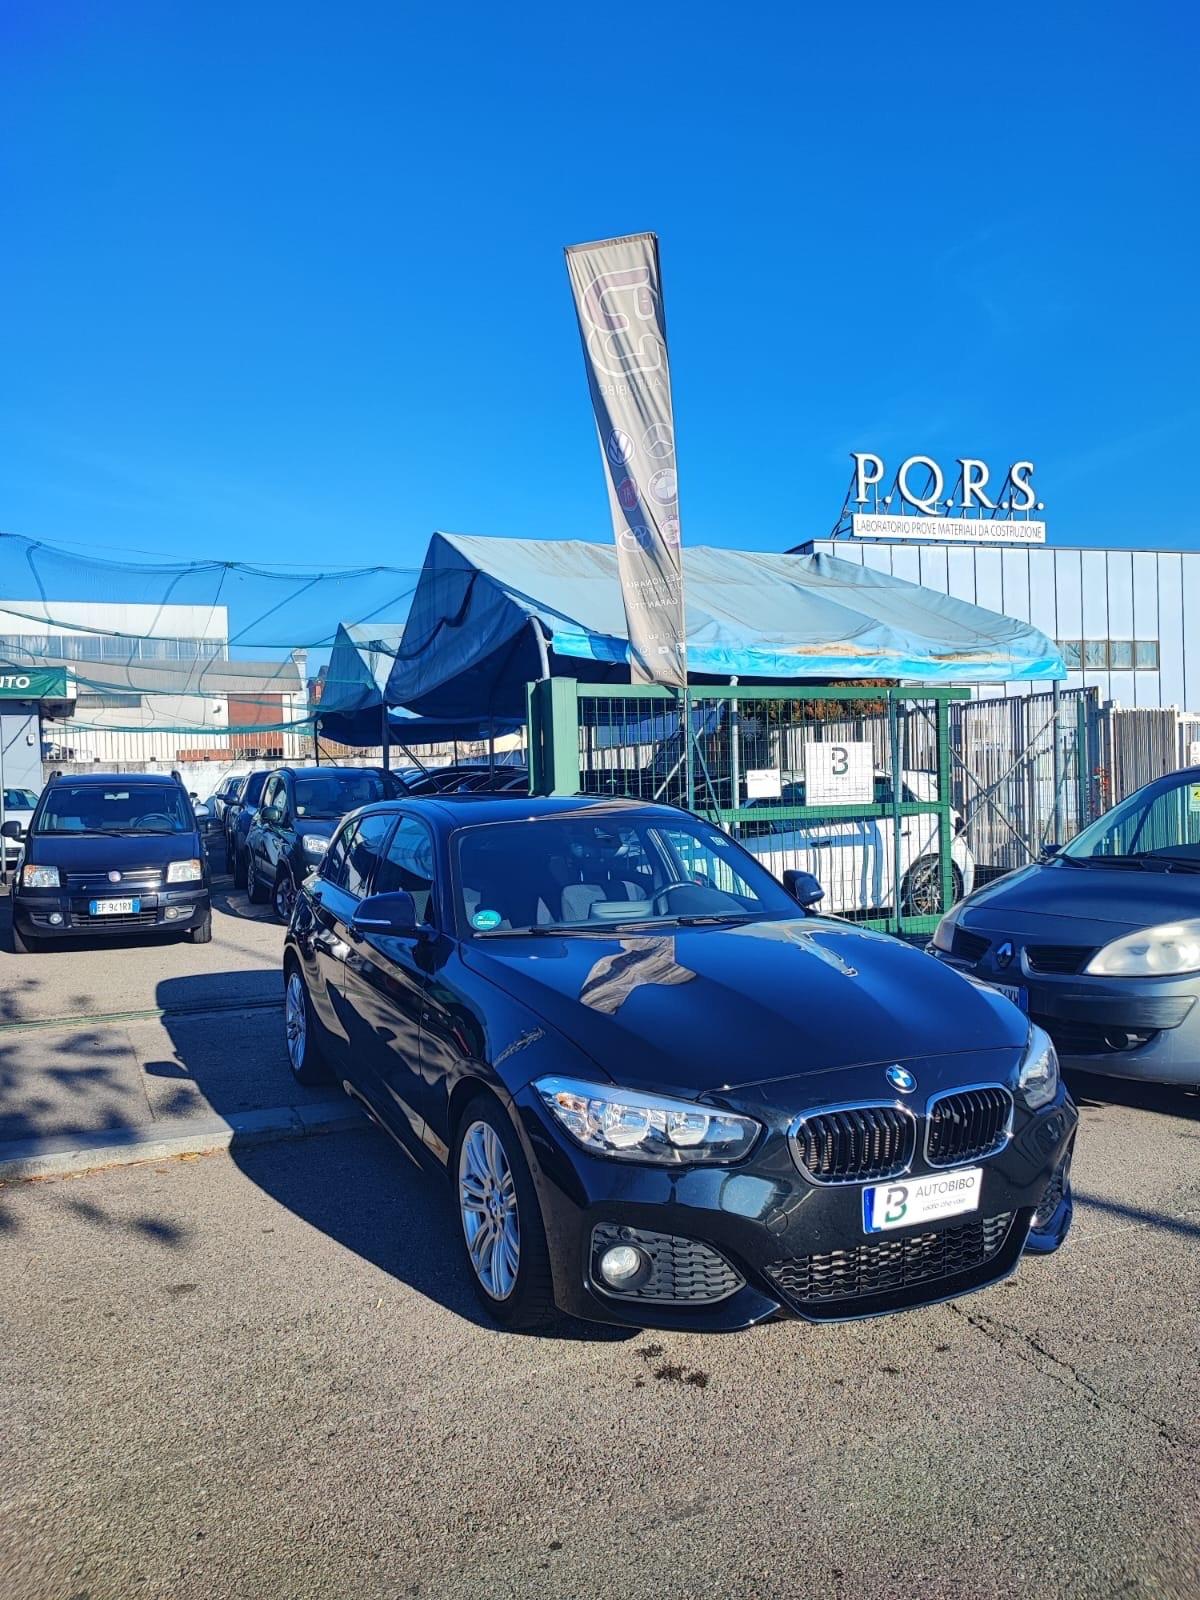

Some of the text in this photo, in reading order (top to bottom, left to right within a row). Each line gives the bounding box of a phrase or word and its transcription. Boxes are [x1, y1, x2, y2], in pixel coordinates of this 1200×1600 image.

[850, 453, 1045, 515] P.Q.R.S.
[856, 520, 1042, 539] LABORATORIO PROVE MATERIALI DA COSTRUZIONE
[97, 903, 106, 912] EF
[915, 1177, 975, 1198] AUTOBIBO
